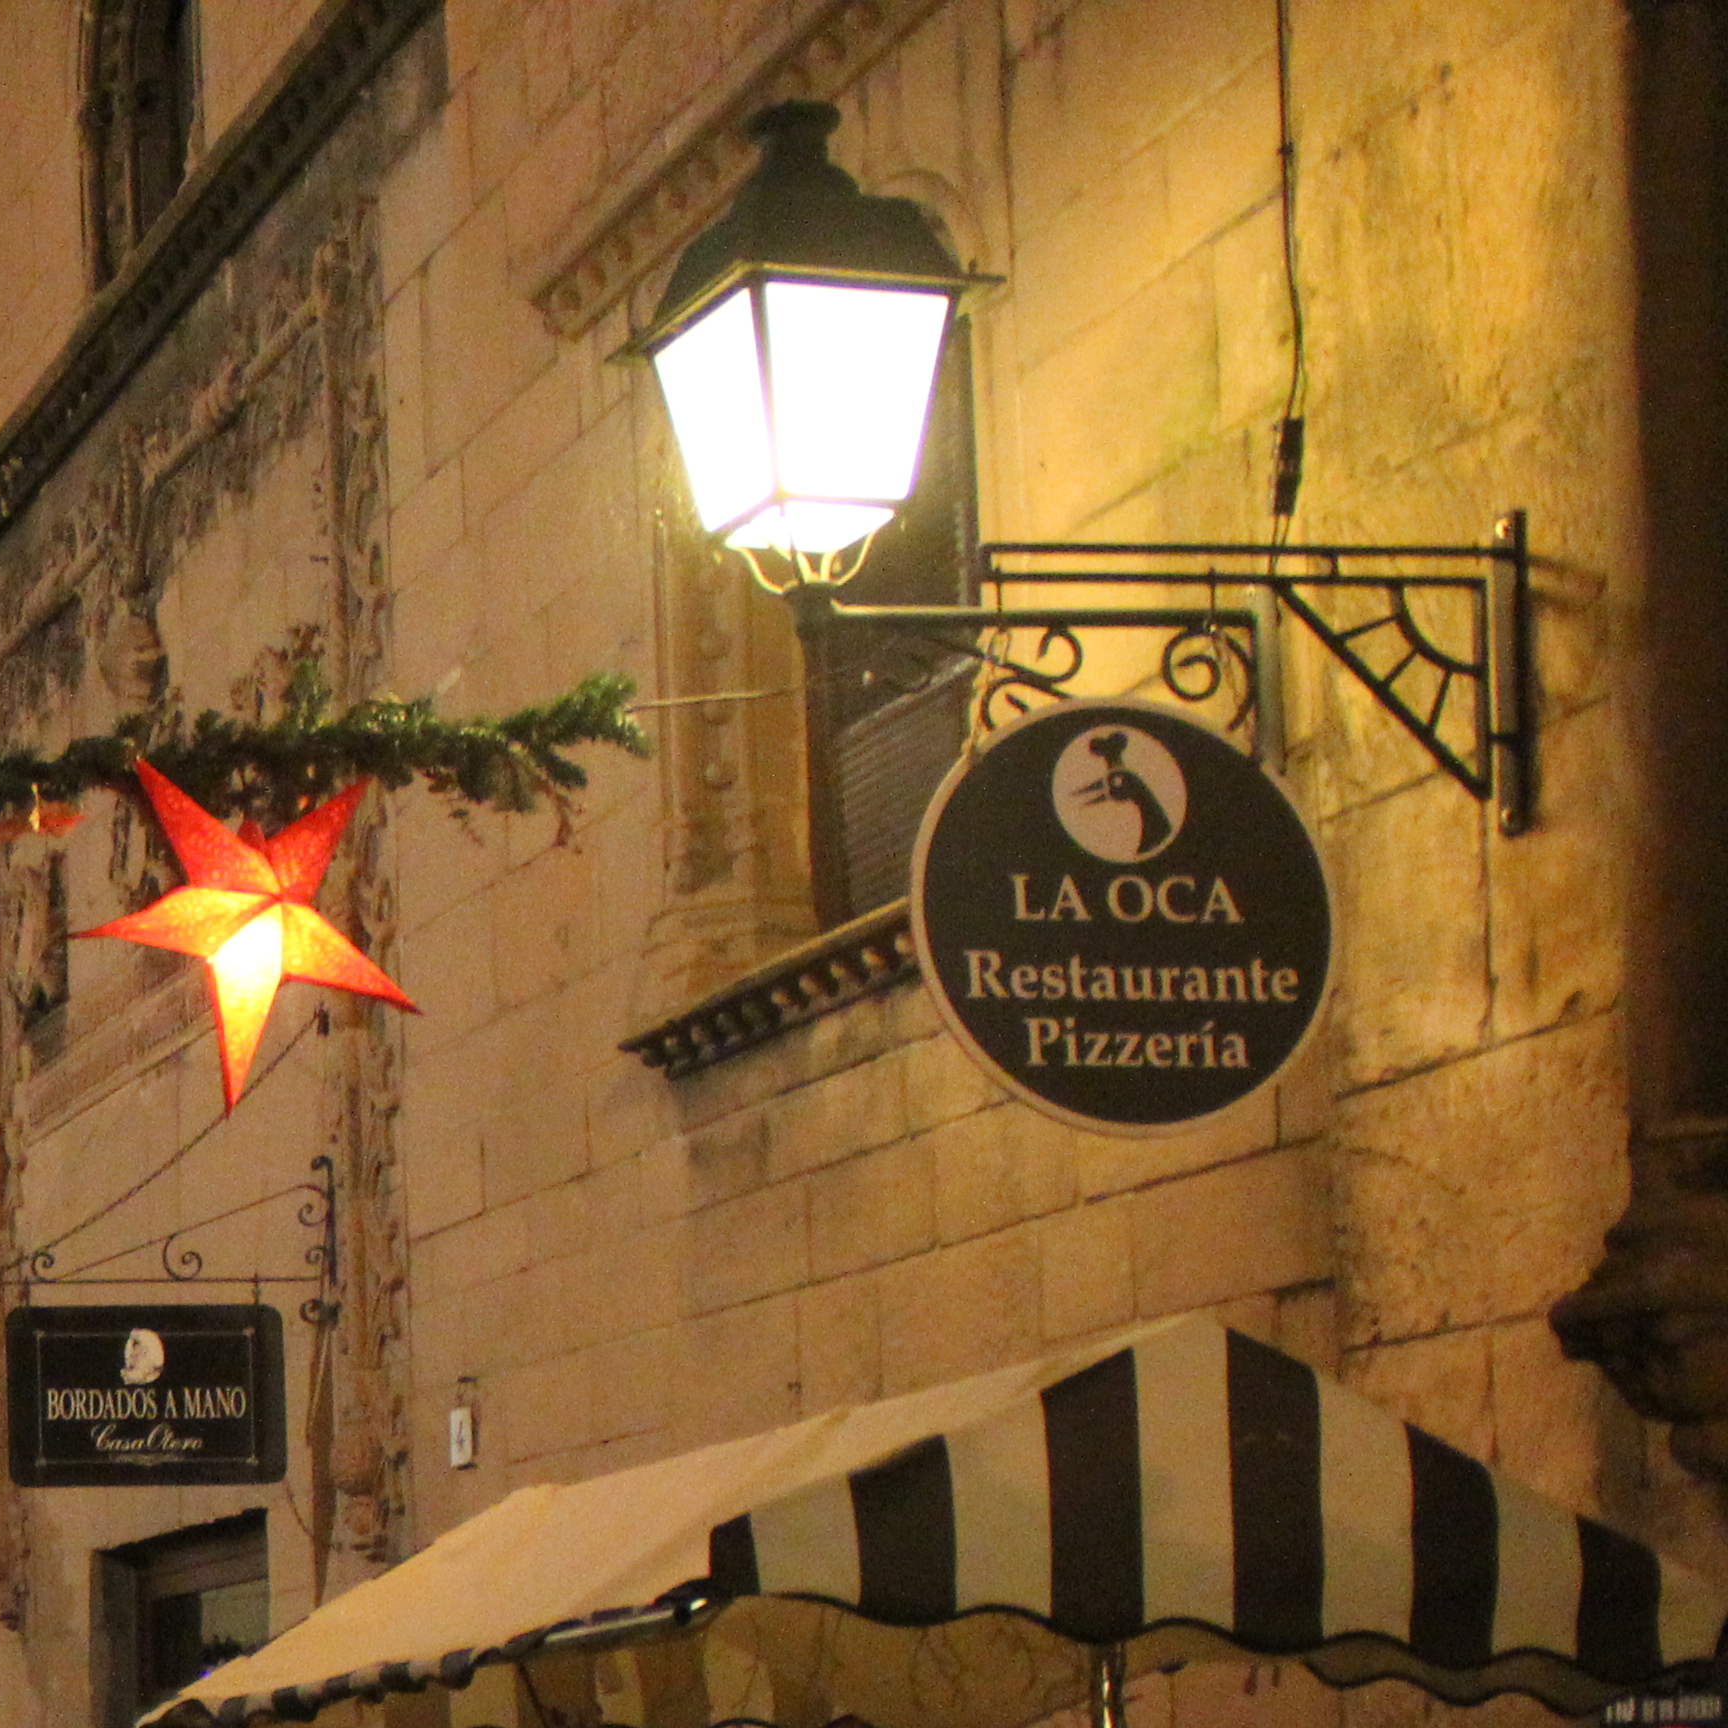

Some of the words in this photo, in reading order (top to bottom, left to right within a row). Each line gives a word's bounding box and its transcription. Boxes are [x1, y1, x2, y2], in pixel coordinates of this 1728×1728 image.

[1008, 873, 1092, 922] LA
[1106, 873, 1245, 924] OCA
[963, 948, 1300, 1001] Restaurante
[1024, 1016, 1249, 1068] Pizzería
[46, 1387, 157, 1421] BORDADOS
[164, 1387, 179, 1419] A
[183, 1386, 247, 1420] MANO
[91, 1422, 144, 1452] Casa
[146, 1421, 204, 1451] Otero
